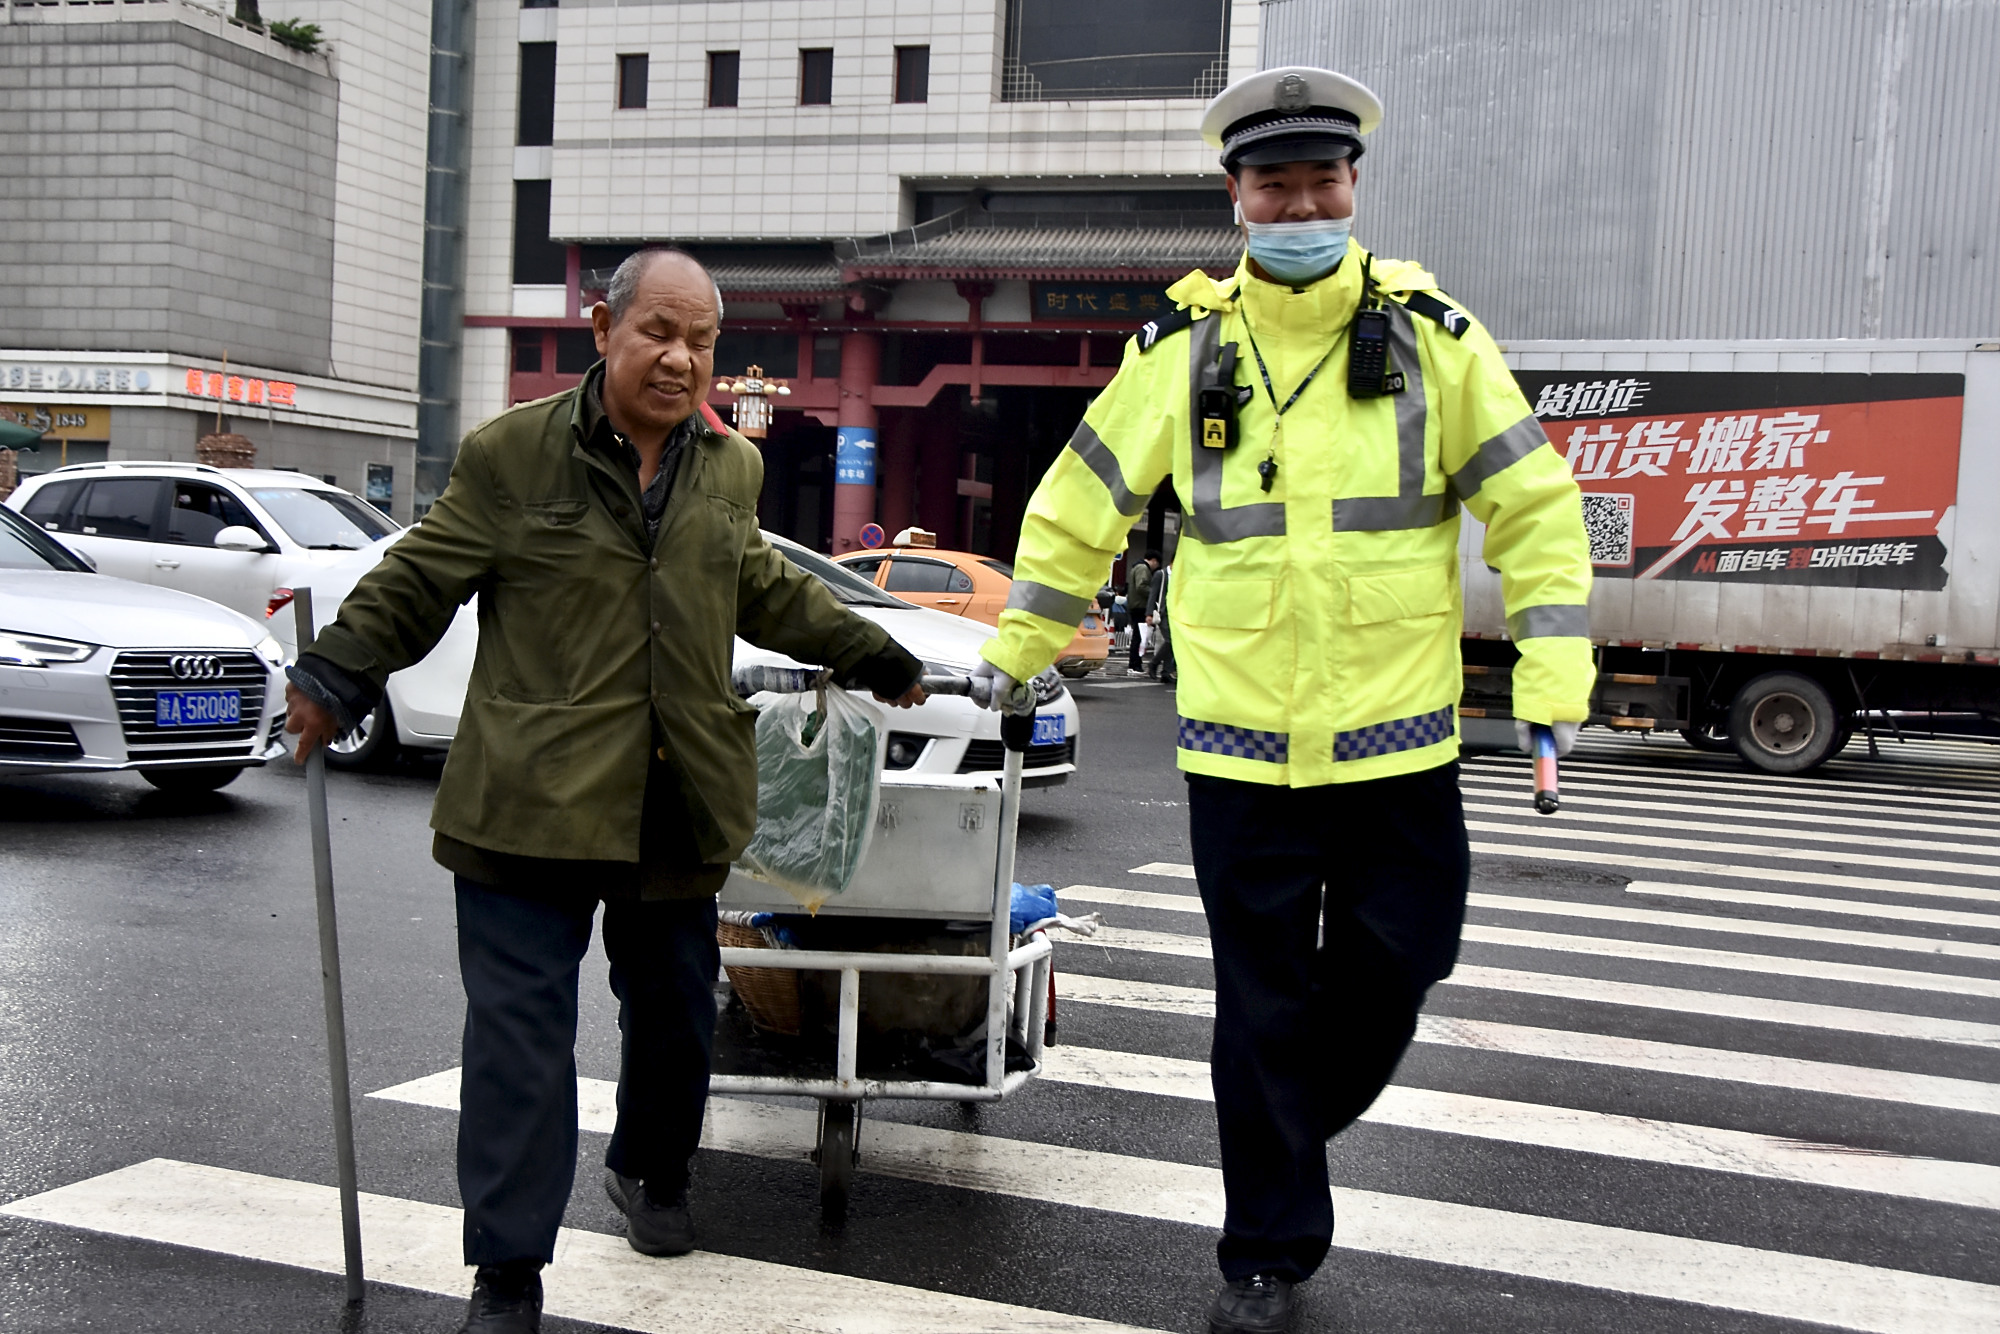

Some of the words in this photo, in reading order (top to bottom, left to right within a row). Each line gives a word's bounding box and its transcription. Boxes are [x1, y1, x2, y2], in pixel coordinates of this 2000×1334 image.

[1534, 378, 1651, 418] 货拉拉
[55, 412, 87, 427] 1848
[1669, 471, 1933, 542] 发整车
[1693, 542, 1918, 575] 从面包车到9米6货车
